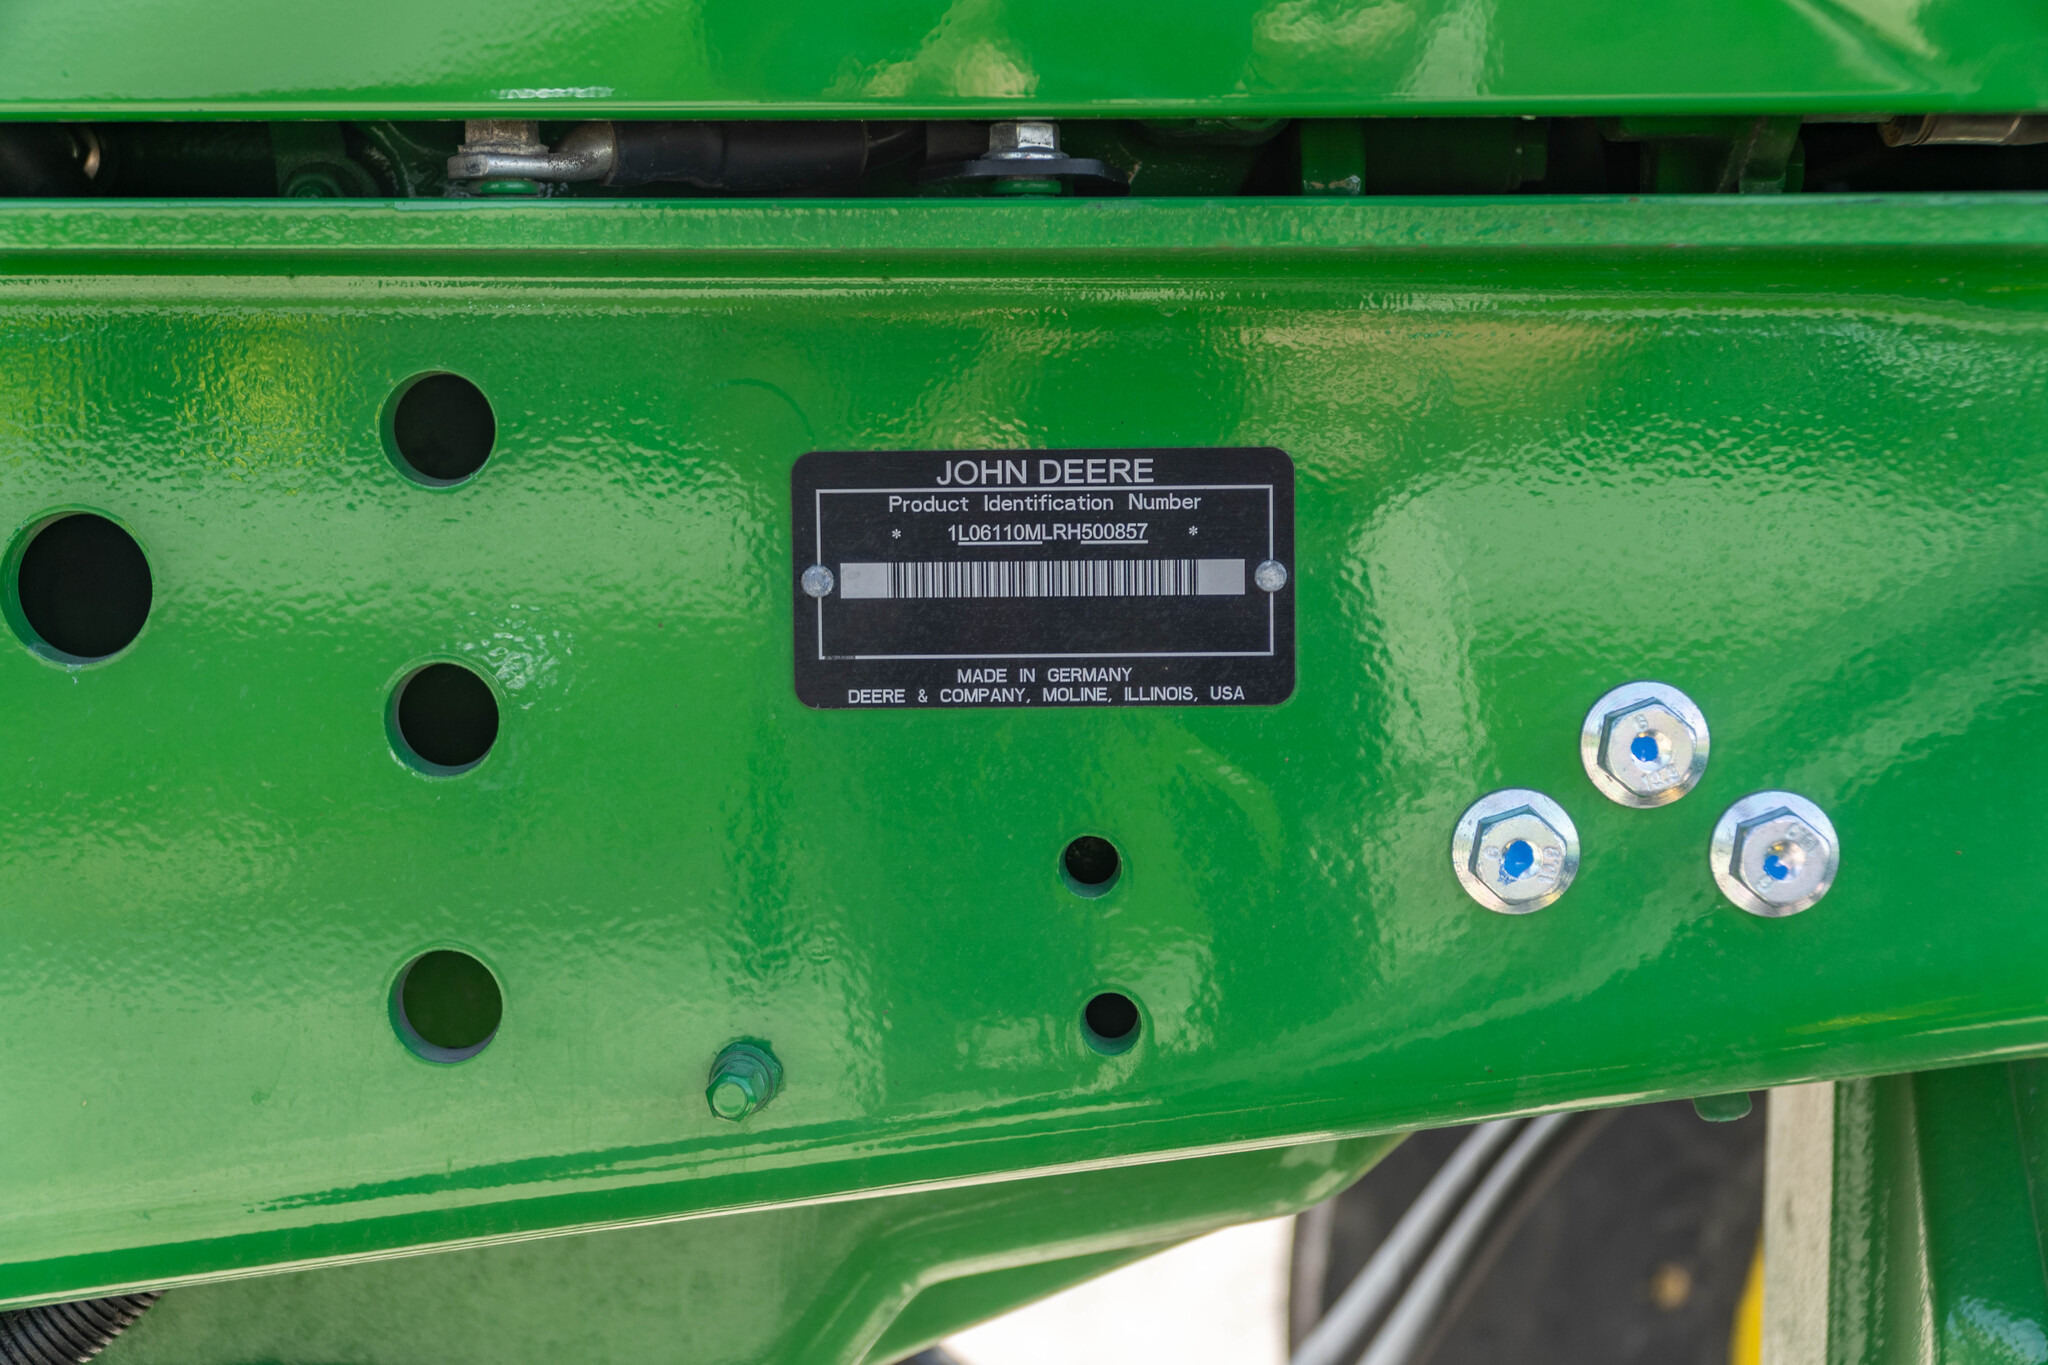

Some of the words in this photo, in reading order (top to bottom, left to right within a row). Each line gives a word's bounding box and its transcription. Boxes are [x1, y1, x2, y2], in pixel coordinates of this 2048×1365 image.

[936, 459, 1027, 485] JOHN
[1039, 458, 1155, 484] DEERE
[888, 495, 970, 513] Product
[984, 493, 1114, 512] Identification
[1128, 492, 1202, 511] Number
[947, 522, 1149, 544] 1L06110MLRH500857
[957, 668, 1008, 684] MADE
[1019, 667, 1036, 683] IN
[1047, 666, 1133, 683] GERMANY
[847, 688, 906, 704] DEERE
[917, 688, 928, 703] &
[939, 687, 1031, 704] COMPANY,
[1042, 686, 1113, 703] MOLINE,
[1124, 685, 1199, 703] ILLINOIS,
[1210, 685, 1246, 701] USA
